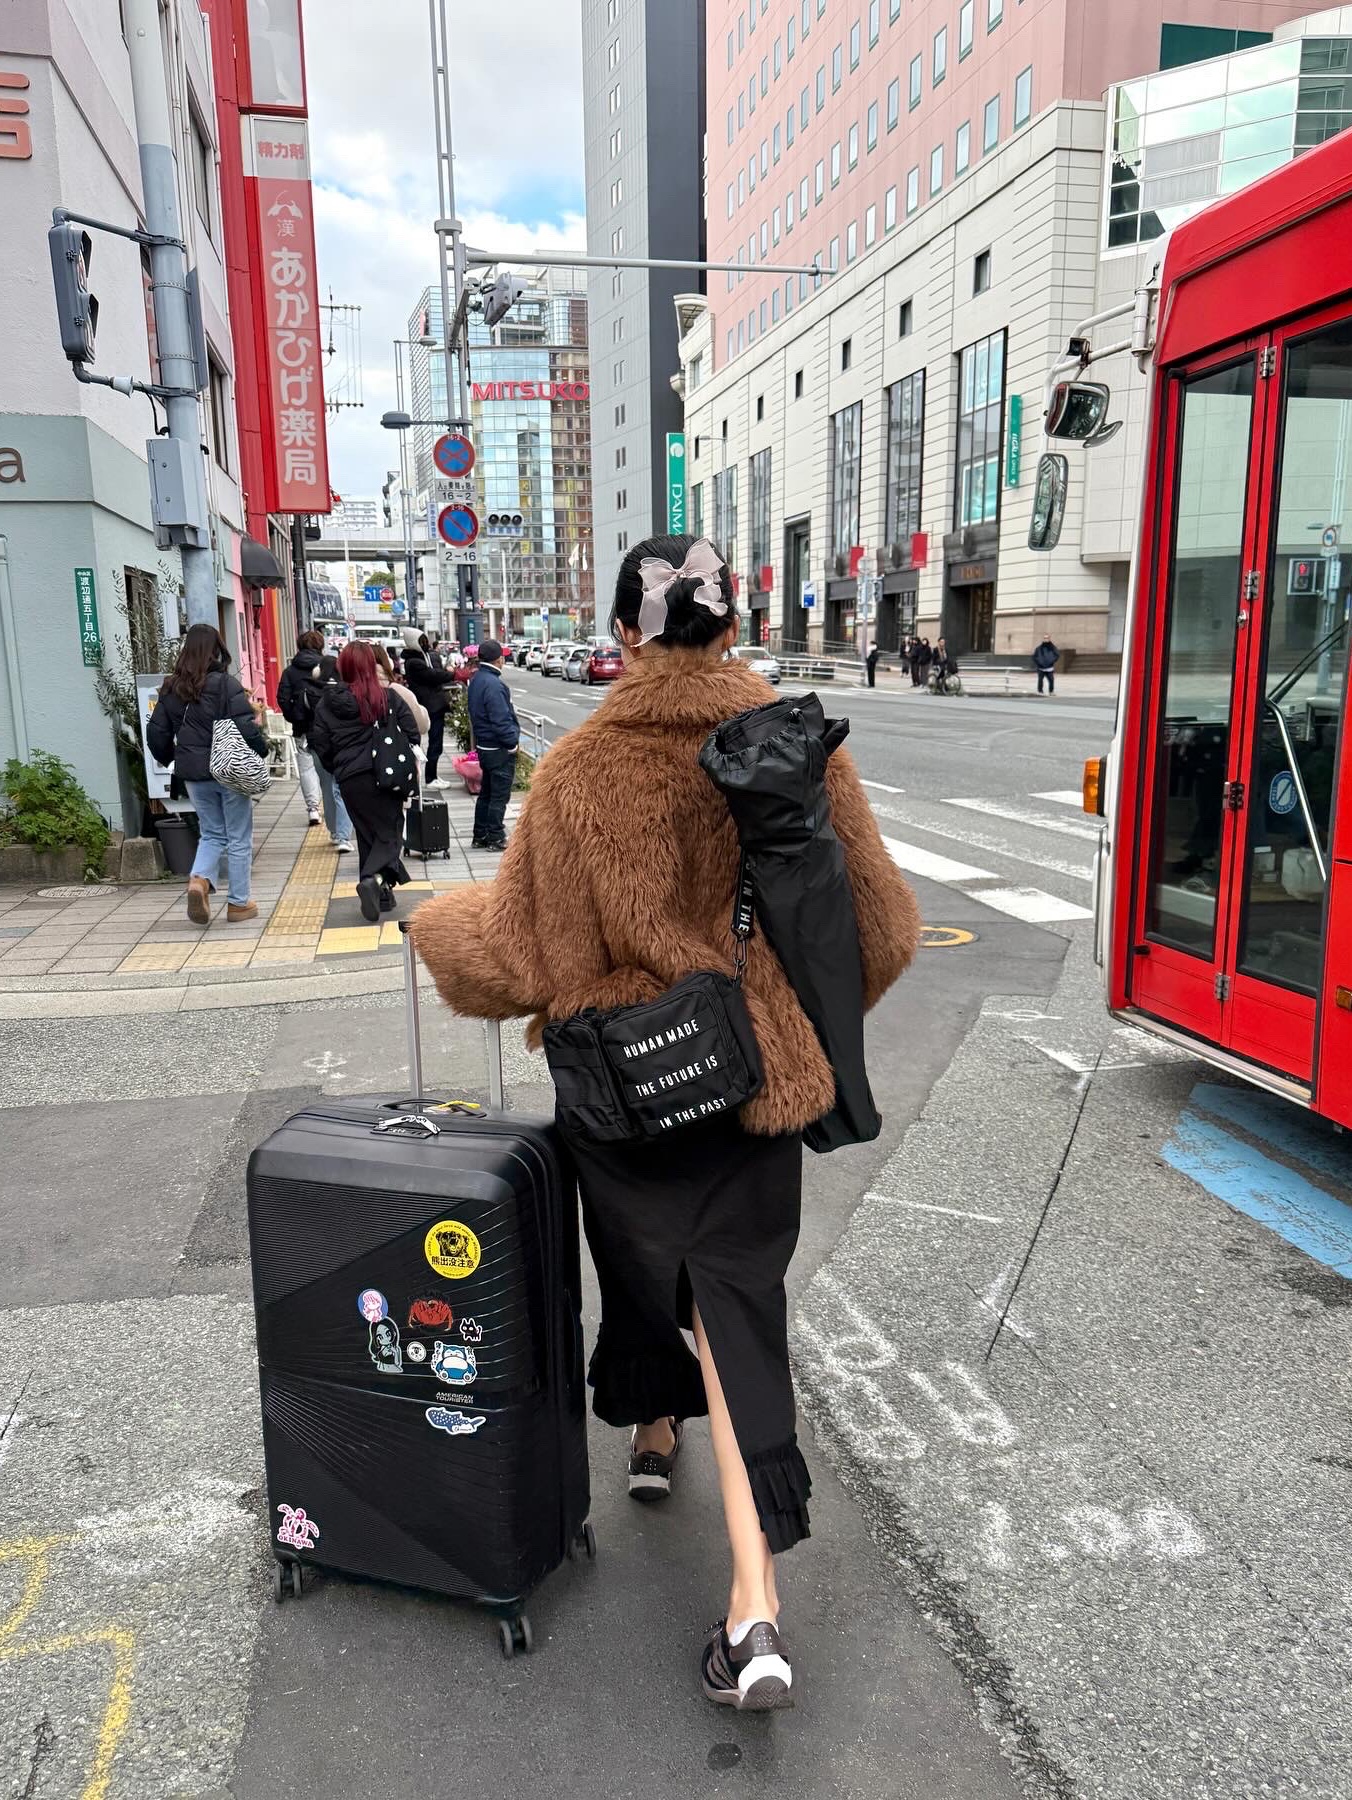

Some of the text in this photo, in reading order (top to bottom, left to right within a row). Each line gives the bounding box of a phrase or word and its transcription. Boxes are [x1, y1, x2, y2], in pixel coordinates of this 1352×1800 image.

[258, 141, 304, 160] 精力剤
[277, 219, 296, 238] 漢
[270, 247, 317, 486] あかひげ薬局
[471, 381, 589, 401] MITSUKO
[445, 551, 477, 561] 2-16
[738, 904, 752, 932] THE
[623, 1019, 700, 1058] HUMAN MADE
[635, 1055, 718, 1097] THE FUTURE IS
[659, 1098, 727, 1128] IN THE PAST
[431, 1256, 475, 1268] 熊出没注意
[436, 1392, 474, 1400] AMERICAN
[278, 1536, 313, 1548] OKINAWA
